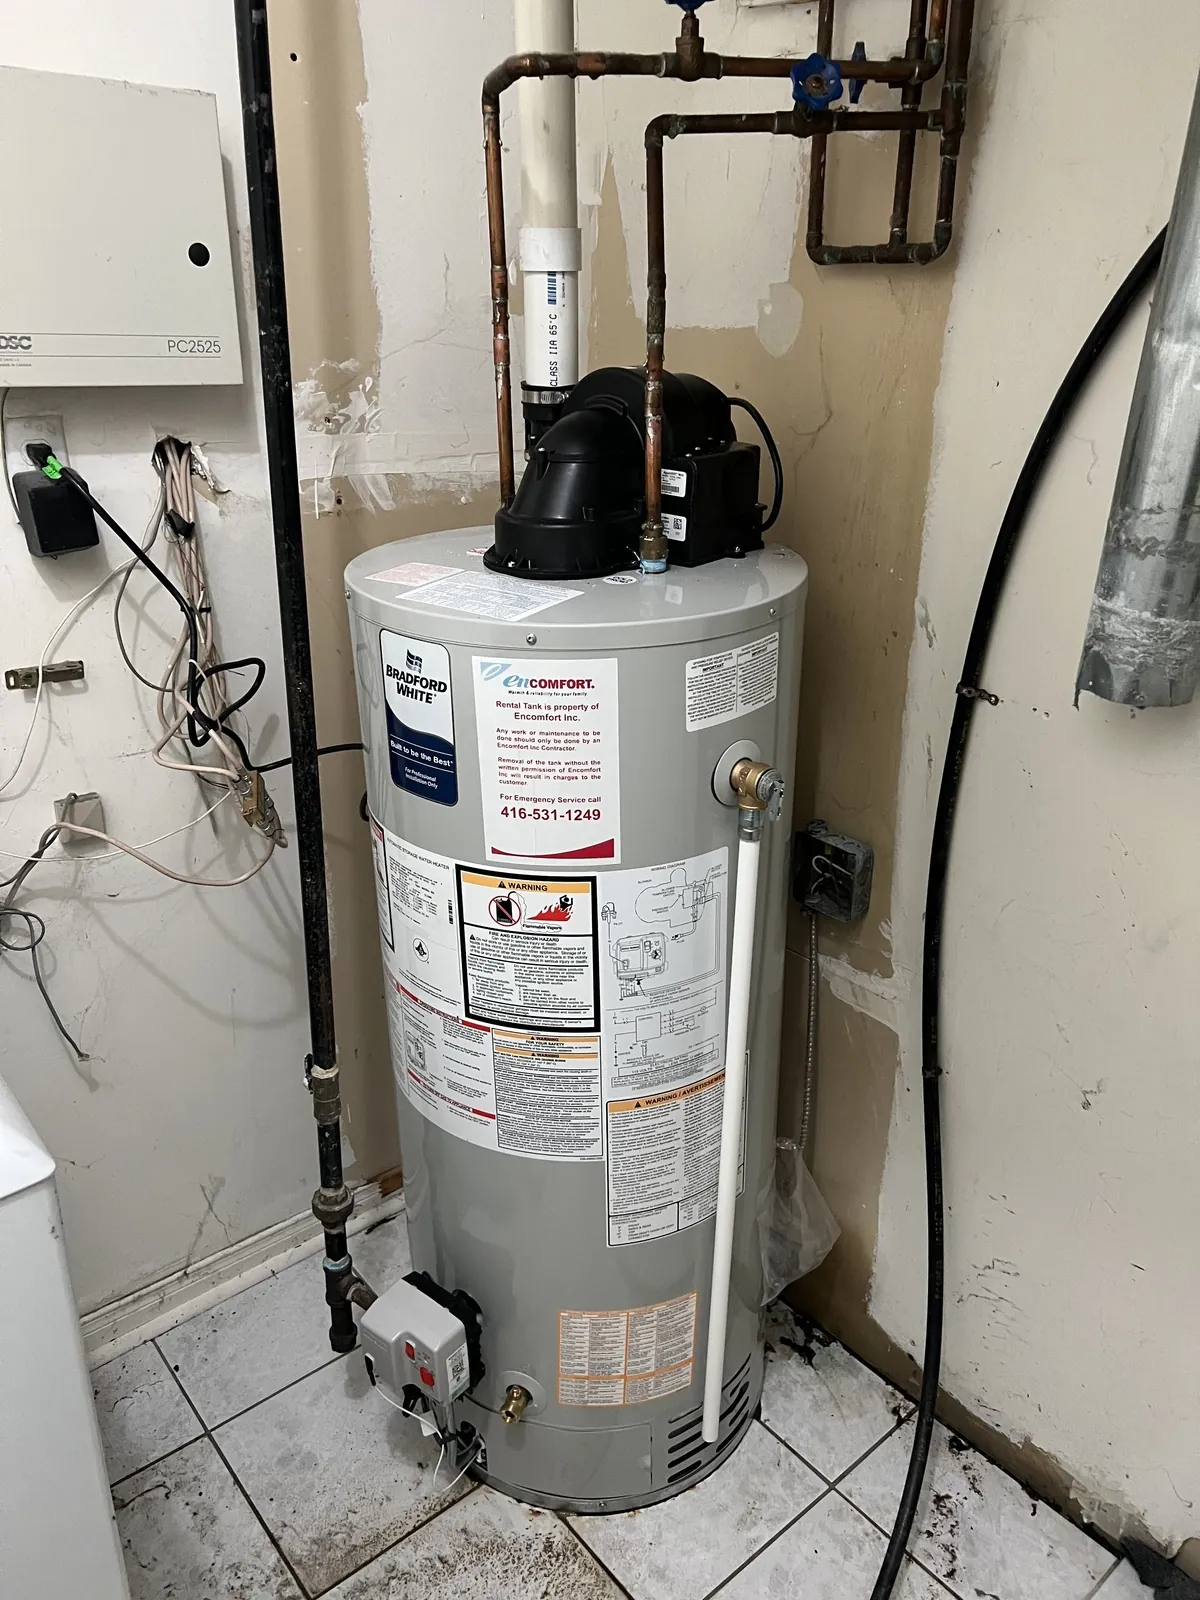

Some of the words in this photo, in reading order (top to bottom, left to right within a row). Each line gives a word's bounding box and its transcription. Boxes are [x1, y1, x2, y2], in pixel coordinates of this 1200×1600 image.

[167, 340, 221, 353] PC2525
[550, 360, 558, 386] CLASS
[386, 664, 448, 692] BRADFORD
[396, 681, 432, 704] WHITE
[496, 701, 521, 709] Rental
[523, 702, 542, 710] Tank
[514, 712, 561, 721] Encomfort
[391, 740, 402, 751] Built
[403, 746, 410, 754] to
[410, 749, 419, 757] be
[420, 753, 431, 761] the
[497, 742, 529, 750] Encomfort
[412, 769, 436, 782] Professional
[428, 781, 438, 789] Only
[514, 795, 555, 804] Emergency
[501, 806, 600, 821] 416-531-1249
[432, 862, 449, 870] HEATER
[508, 882, 548, 892] WARNING
[645, 1094, 678, 1105] WARNING
[682, 1073, 725, 1096] AVERTISSEMEN
